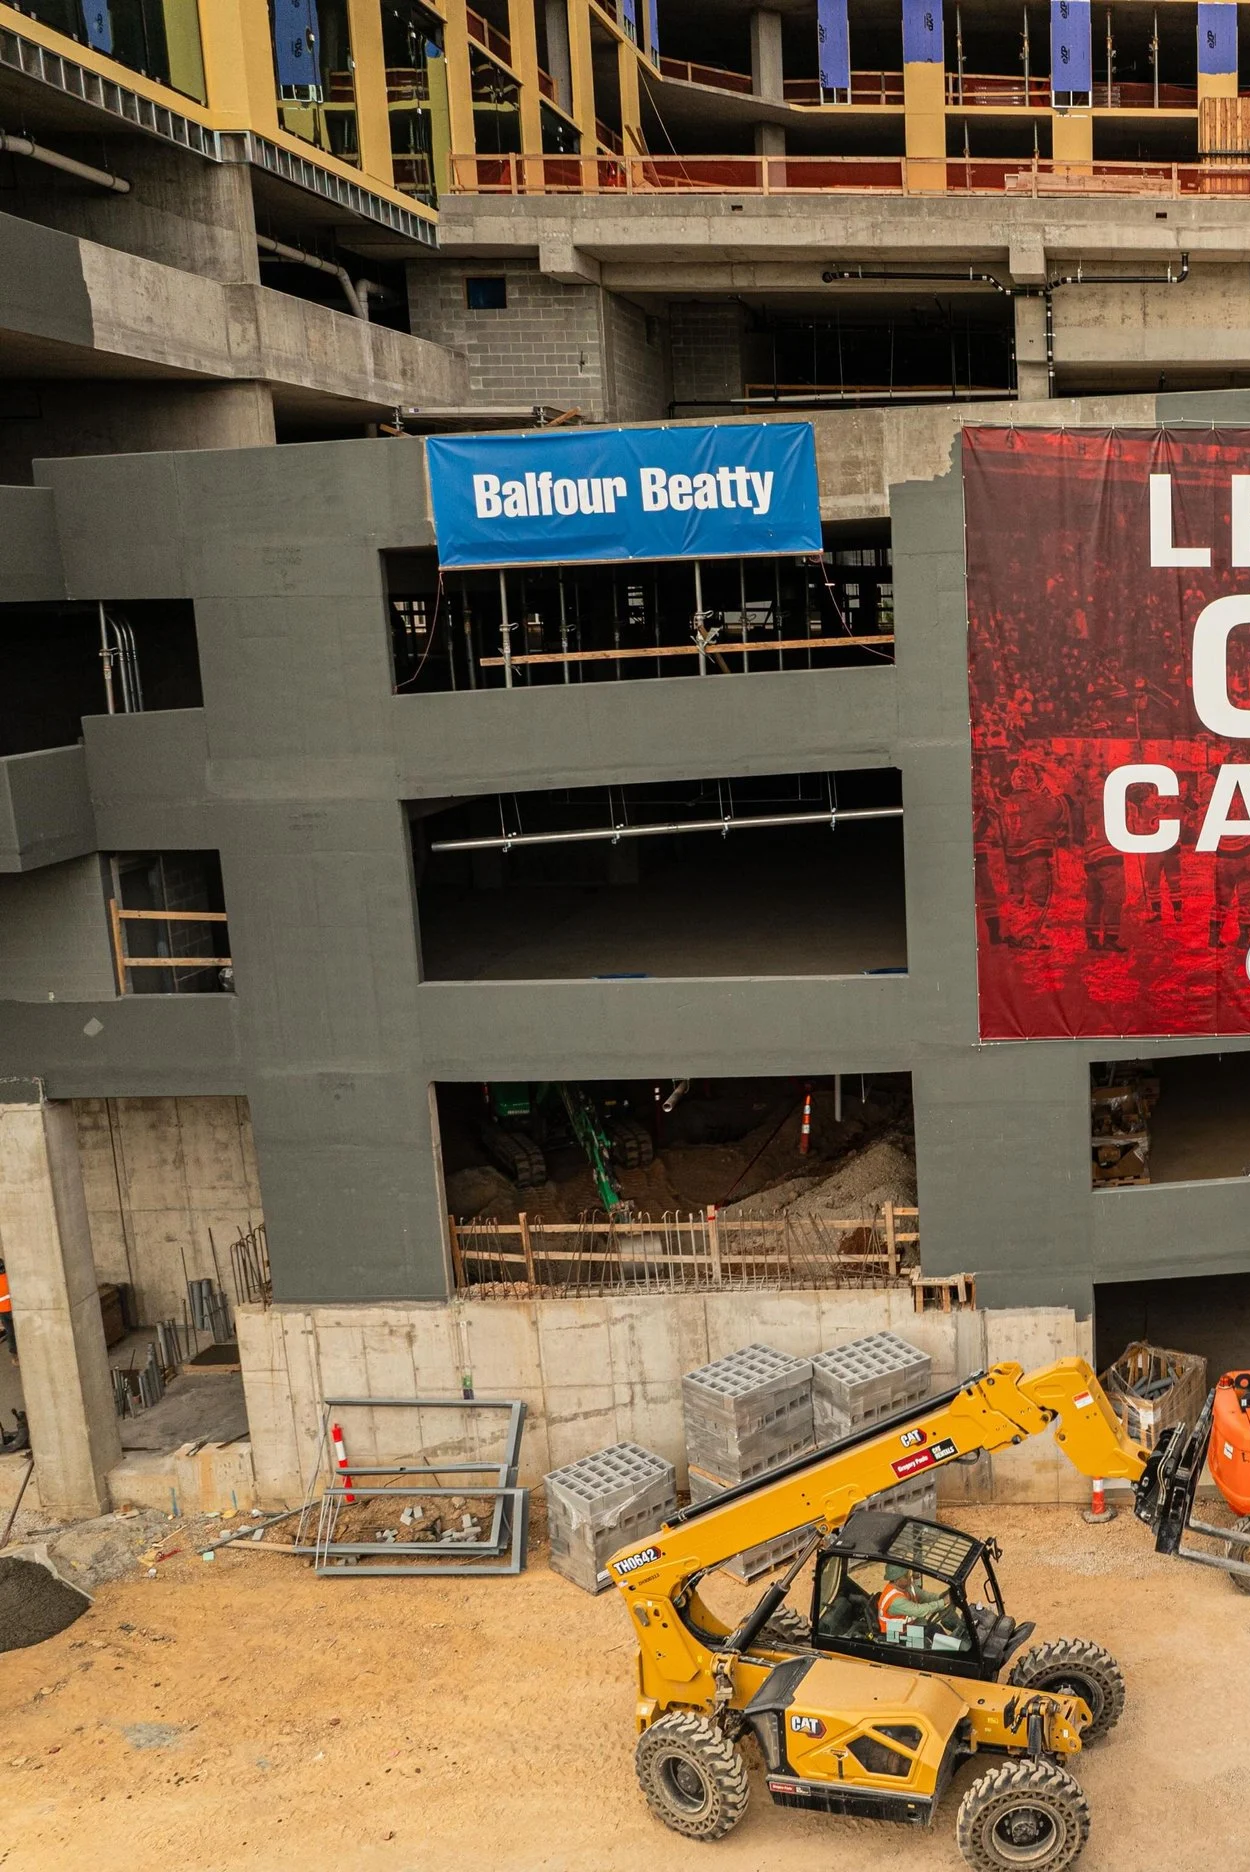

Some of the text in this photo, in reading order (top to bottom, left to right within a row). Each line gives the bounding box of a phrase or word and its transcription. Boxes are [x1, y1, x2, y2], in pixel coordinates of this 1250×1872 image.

[1206, 30, 1215, 49] eXP
[1060, 46, 1068, 64] eXP
[473, 464, 774, 518] Balfour Beatty
[900, 1429, 922, 1448] CAT
[790, 1715, 819, 1734] CAT
